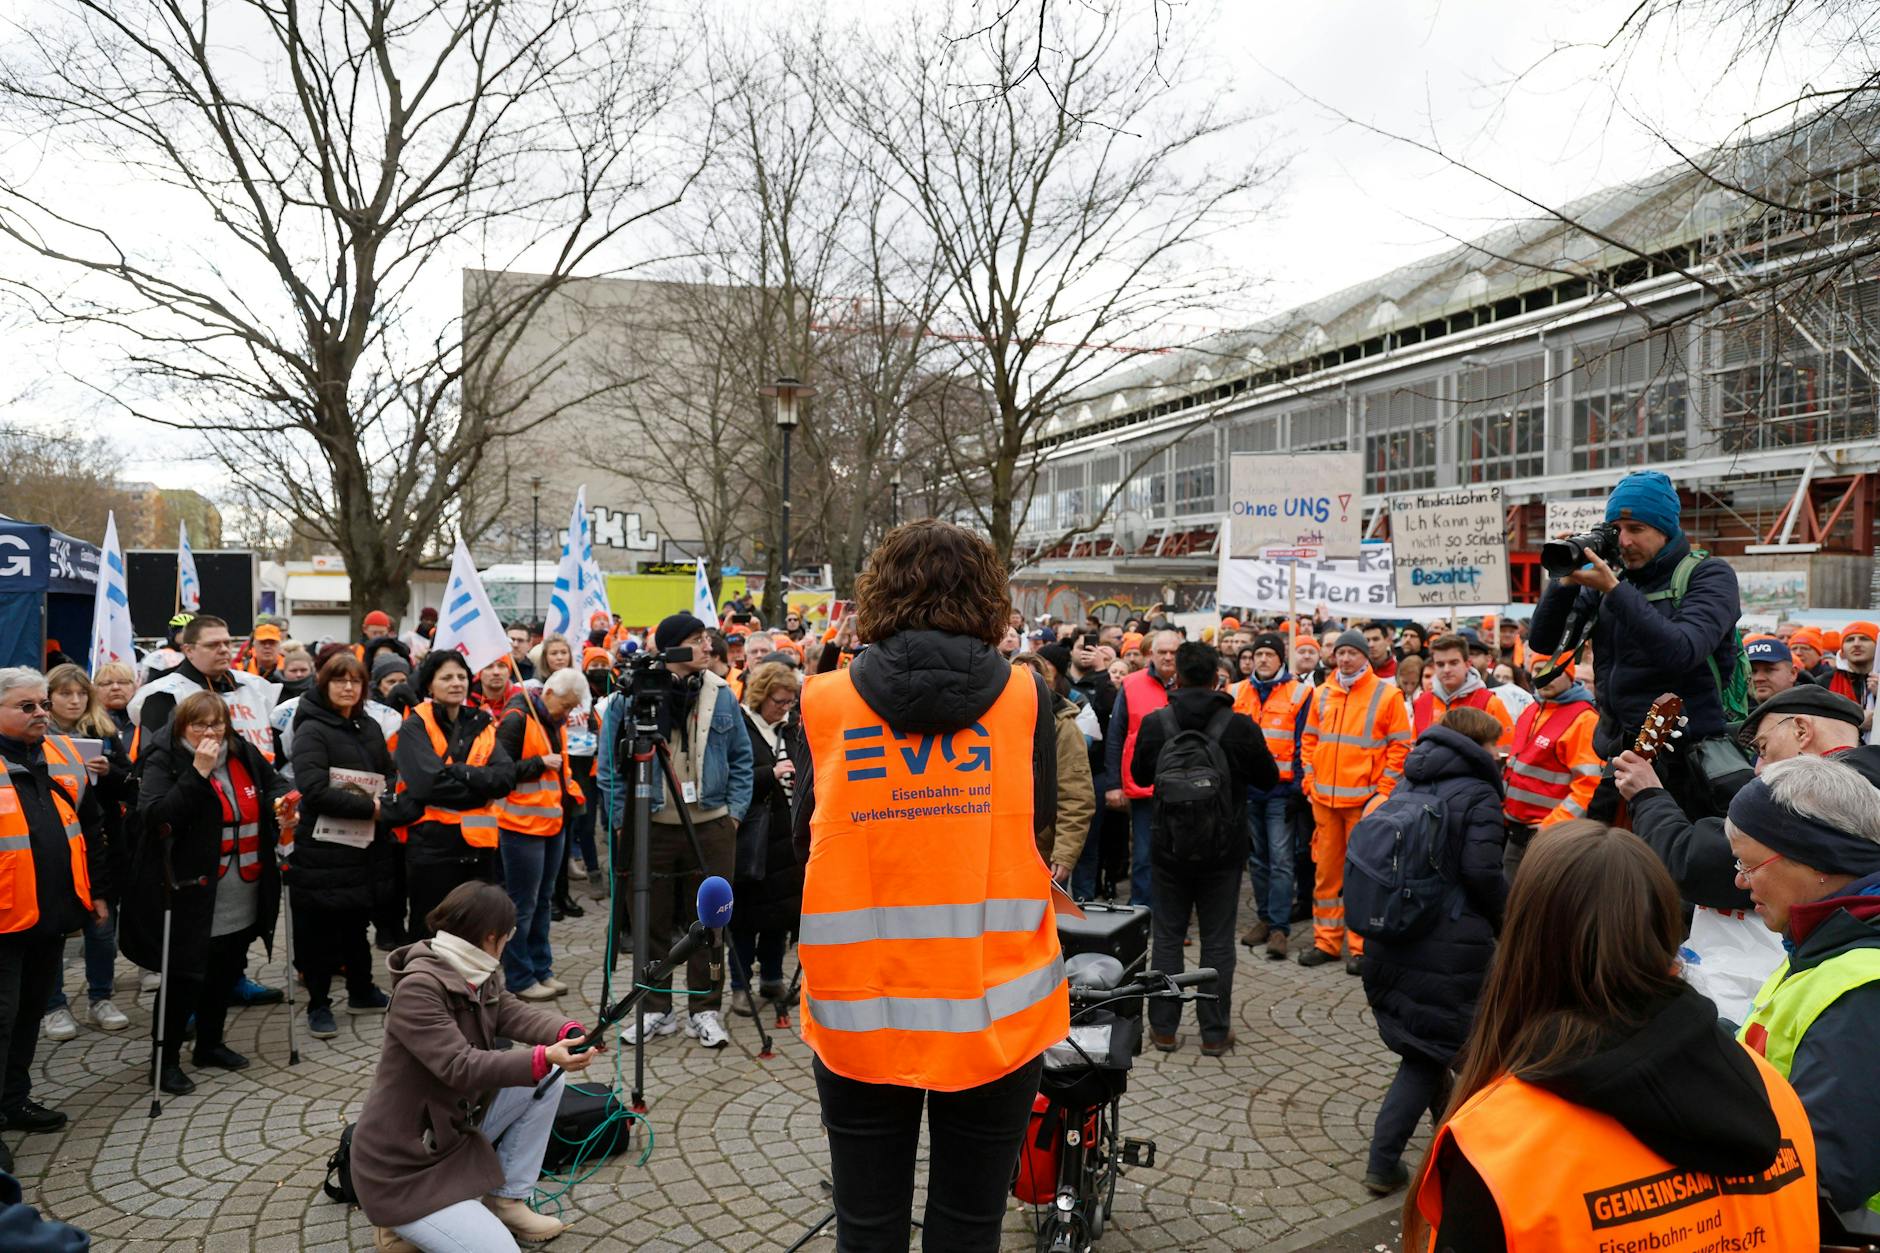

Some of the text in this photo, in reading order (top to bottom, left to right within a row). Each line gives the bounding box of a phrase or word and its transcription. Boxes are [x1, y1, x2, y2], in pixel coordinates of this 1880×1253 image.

[1233, 501, 1277, 516] Ohne
[1405, 515, 1427, 531] Ich
[1412, 533, 1441, 548] nicht
[1358, 548, 1391, 573] Rä
[1474, 549, 1496, 565] ich
[1412, 565, 1482, 586] Bezahlt
[1748, 644, 1772, 655] EVG
[844, 721, 991, 781] EVG
[892, 784, 991, 801] Eisenbahn- und
[851, 801, 991, 823] Verkehrsgewerkschaft
[716, 900, 734, 914] AFP
[1594, 1173, 1714, 1220] GEMEINSAM
[1599, 1209, 1722, 1253] Eisenbahn- und
